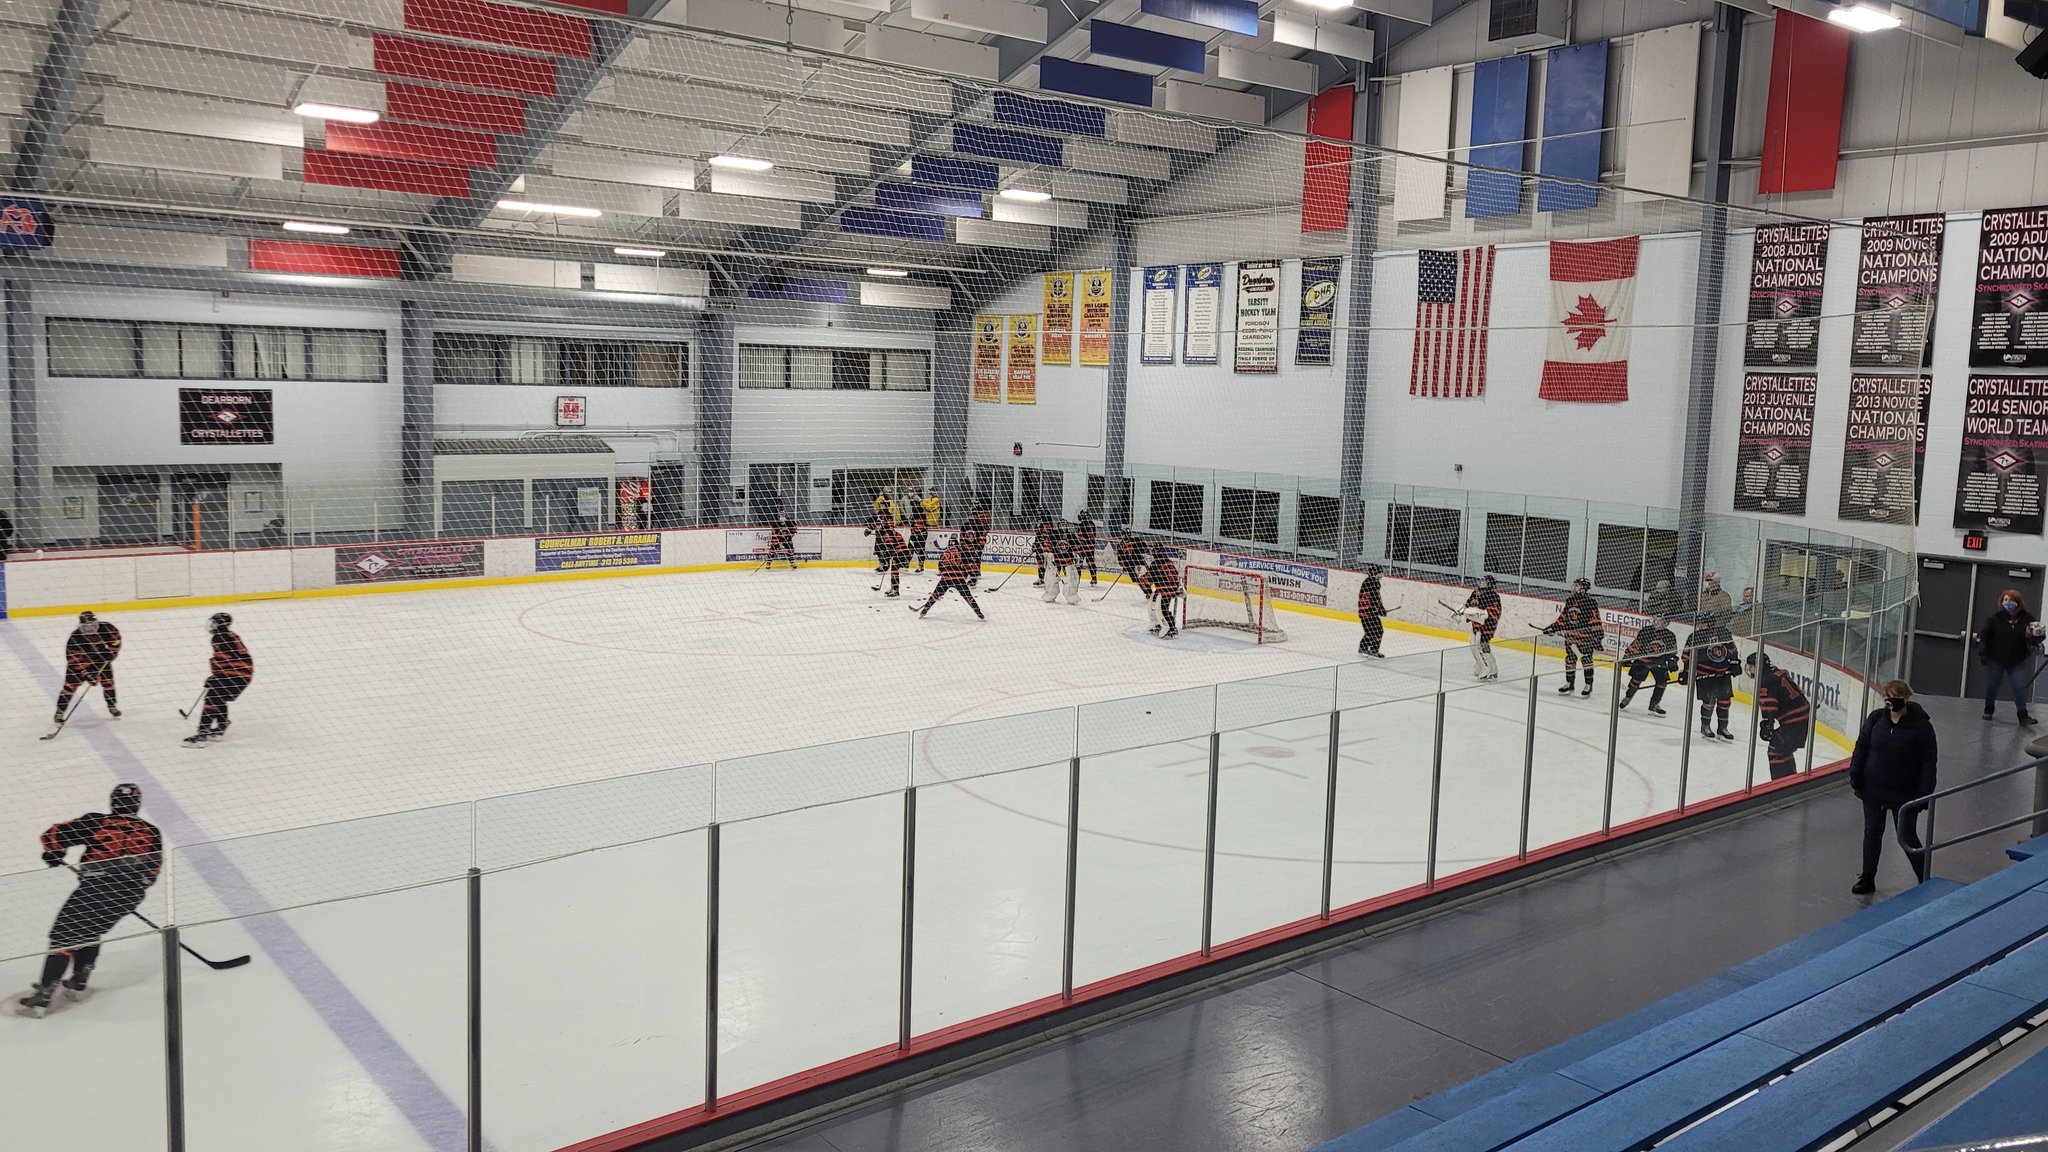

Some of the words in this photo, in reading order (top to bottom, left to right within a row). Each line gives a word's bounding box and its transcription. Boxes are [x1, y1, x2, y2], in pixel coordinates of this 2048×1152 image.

[1756, 225, 1829, 243] CRYSTALLETTES
[1863, 217, 1944, 238] CRYSTALLETTES
[1866, 238, 1893, 252] 2009
[1989, 231, 2020, 246] 2009
[1761, 244, 1786, 257] 2008
[1787, 243, 1820, 256] ADULT
[1755, 258, 1824, 273] NATIONAL
[1862, 252, 1939, 269] NATIONAL
[1861, 268, 1938, 284] CHAMPIONS
[1980, 263, 2048, 280] CHAMPIO
[1754, 273, 1823, 288] CHAMPIONS
[1745, 376, 1817, 392] CRYSTALLETTES
[1852, 378, 1931, 395] CRYSTALLETTES
[201, 395, 252, 404] DEARBORN
[1743, 393, 1766, 405] 2013
[1767, 393, 1815, 406] JUVENILE
[1855, 395, 1881, 408] 2013
[1882, 396, 1924, 409] NOVICE
[1969, 398, 1999, 414] 2014
[2001, 399, 2048, 415] SENIOR
[1744, 406, 1812, 421] NATIONAL
[1851, 410, 1925, 425] NATIONAL
[191, 429, 264, 438] CRYSTALLETTES
[1743, 421, 1811, 436] CHAMPIONS
[1849, 425, 1925, 441] CHAMPIONS
[1967, 418, 2014, 434] WORLD
[539, 538, 587, 549] COUNCILMAN
[588, 536, 616, 547] ROBERT
[624, 534, 658, 544] ABRAHAM
[985, 535, 1034, 547] ORWICK
[1966, 537, 1983, 549] EXIT
[561, 560, 574, 568] CALL
[1239, 561, 1247, 569] MY
[1249, 561, 1274, 570] SERVICE
[1275, 563, 1290, 574] WILL
[1291, 566, 1310, 577] MOVE
[1311, 572, 1325, 584] YOU
[1268, 576, 1302, 588] ARWISH
[1790, 671, 1841, 710] umont
